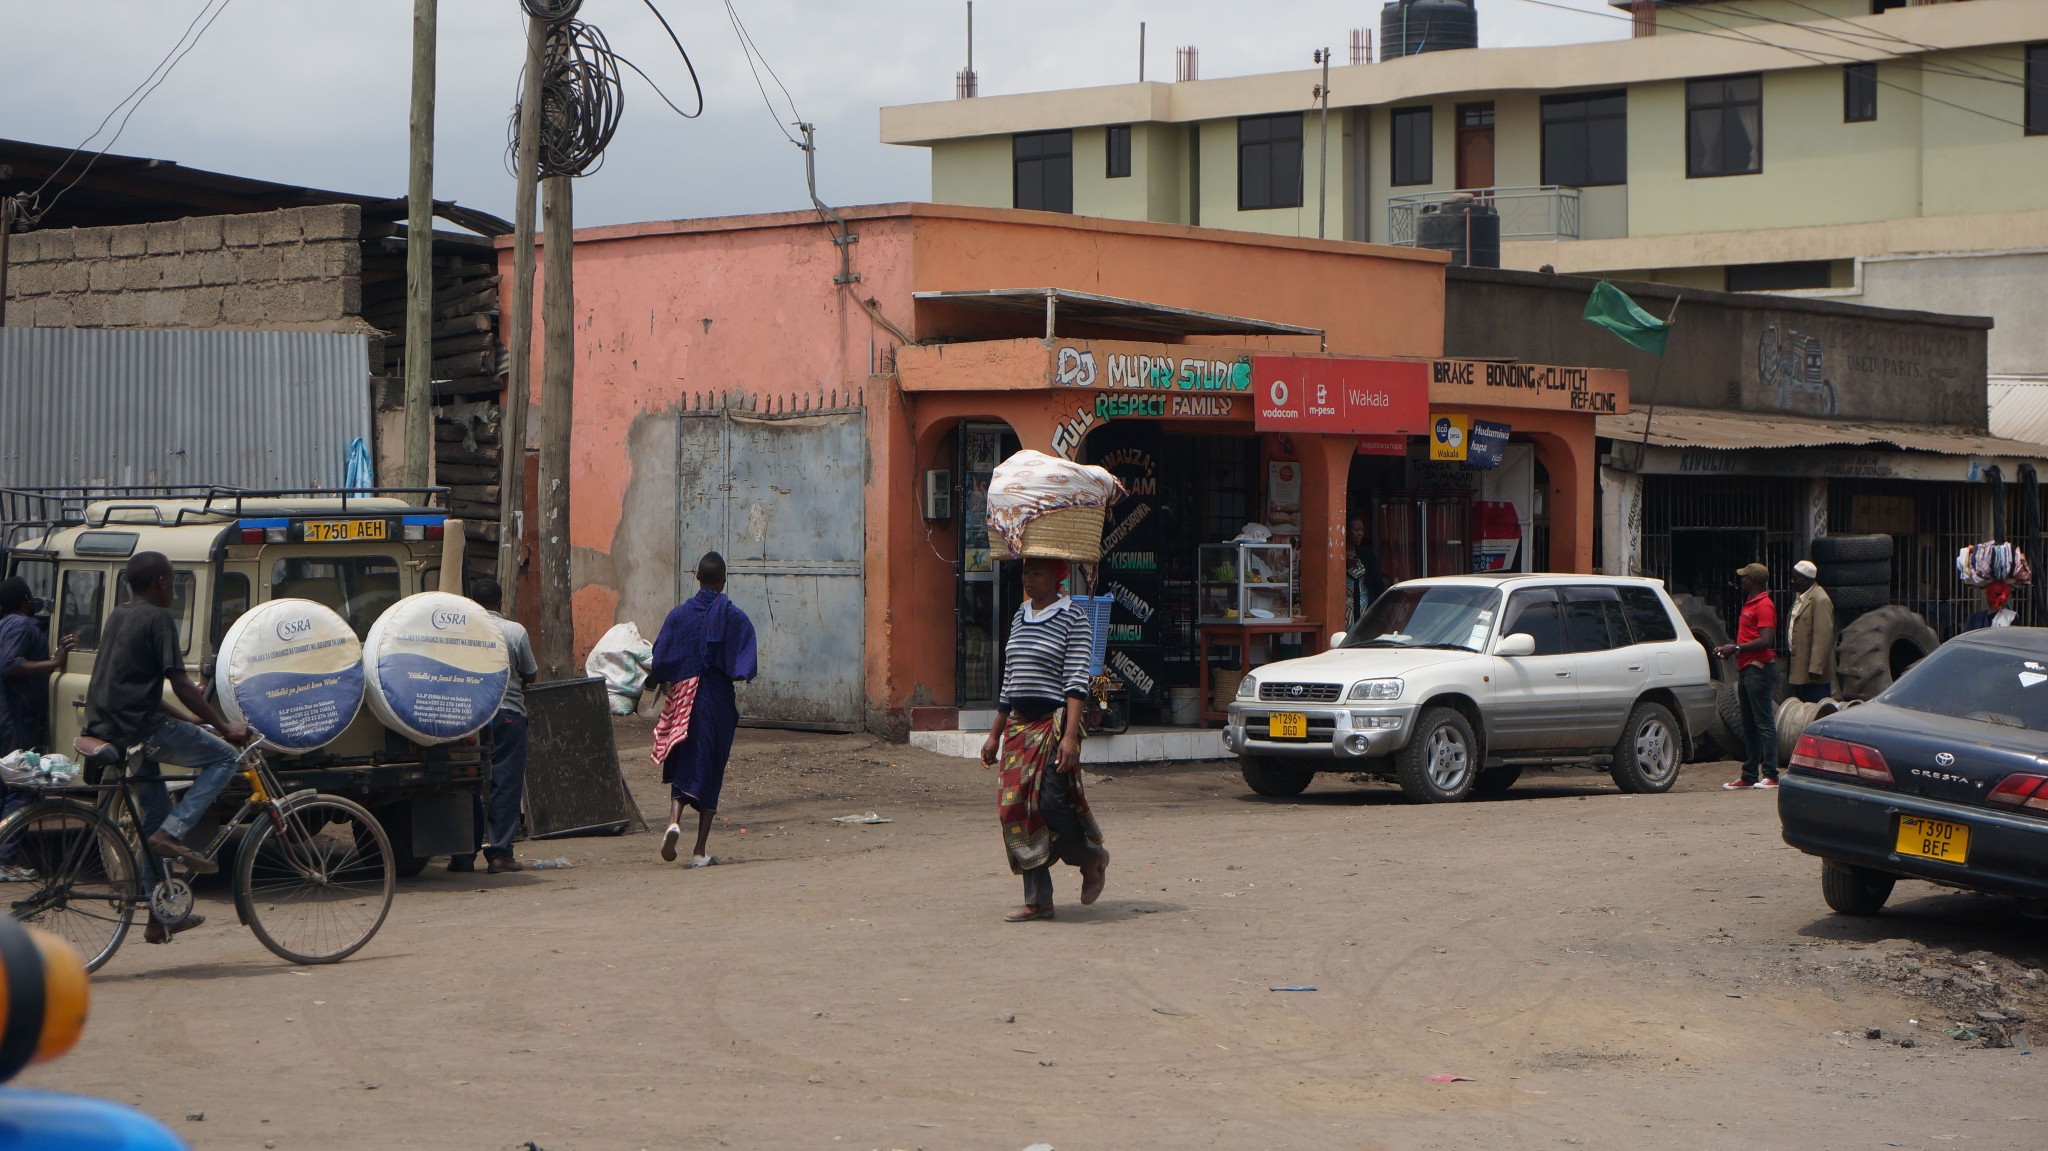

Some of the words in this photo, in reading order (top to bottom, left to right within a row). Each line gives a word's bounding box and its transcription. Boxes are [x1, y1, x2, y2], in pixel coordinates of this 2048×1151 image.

[1055, 347, 1098, 386] DJ
[1847, 354, 1877, 373] USED
[1433, 361, 1474, 385] BRAKE
[1486, 364, 1536, 388] BONDING
[1546, 367, 1588, 391] CLUTCH
[1348, 388, 1389, 407] Wakala
[1570, 391, 1616, 414] REFACING
[1262, 408, 1298, 418] vodacom
[1309, 406, 1336, 417] m-pesa
[1051, 407, 1095, 462] FULL
[1095, 392, 1167, 422] RESPECT
[1172, 396, 1232, 416] FAMILY
[1474, 425, 1510, 440] Hudumiwa
[1390, 442, 1402, 451] hapa
[1438, 449, 1459, 458] Wakala
[1470, 440, 1488, 454] hapa
[1101, 448, 1156, 476] NAUZA;
[1121, 476, 1157, 496] LAM
[357, 521, 382, 537] AEH
[1100, 502, 1152, 558] LIZOTAFSIRIWA
[1110, 580, 1155, 623] KIHINDI
[284, 618, 312, 634] SSRA
[438, 612, 466, 626] SSRA
[1107, 624, 1142, 642] ZUNGU
[1112, 651, 1155, 696] NIGERIA
[1278, 713, 1298, 724] T296
[1283, 726, 1297, 736] DGD
[1911, 768, 1968, 784] CRESTA
[1917, 820, 1953, 840] T390
[1922, 838, 1950, 857] BEF
